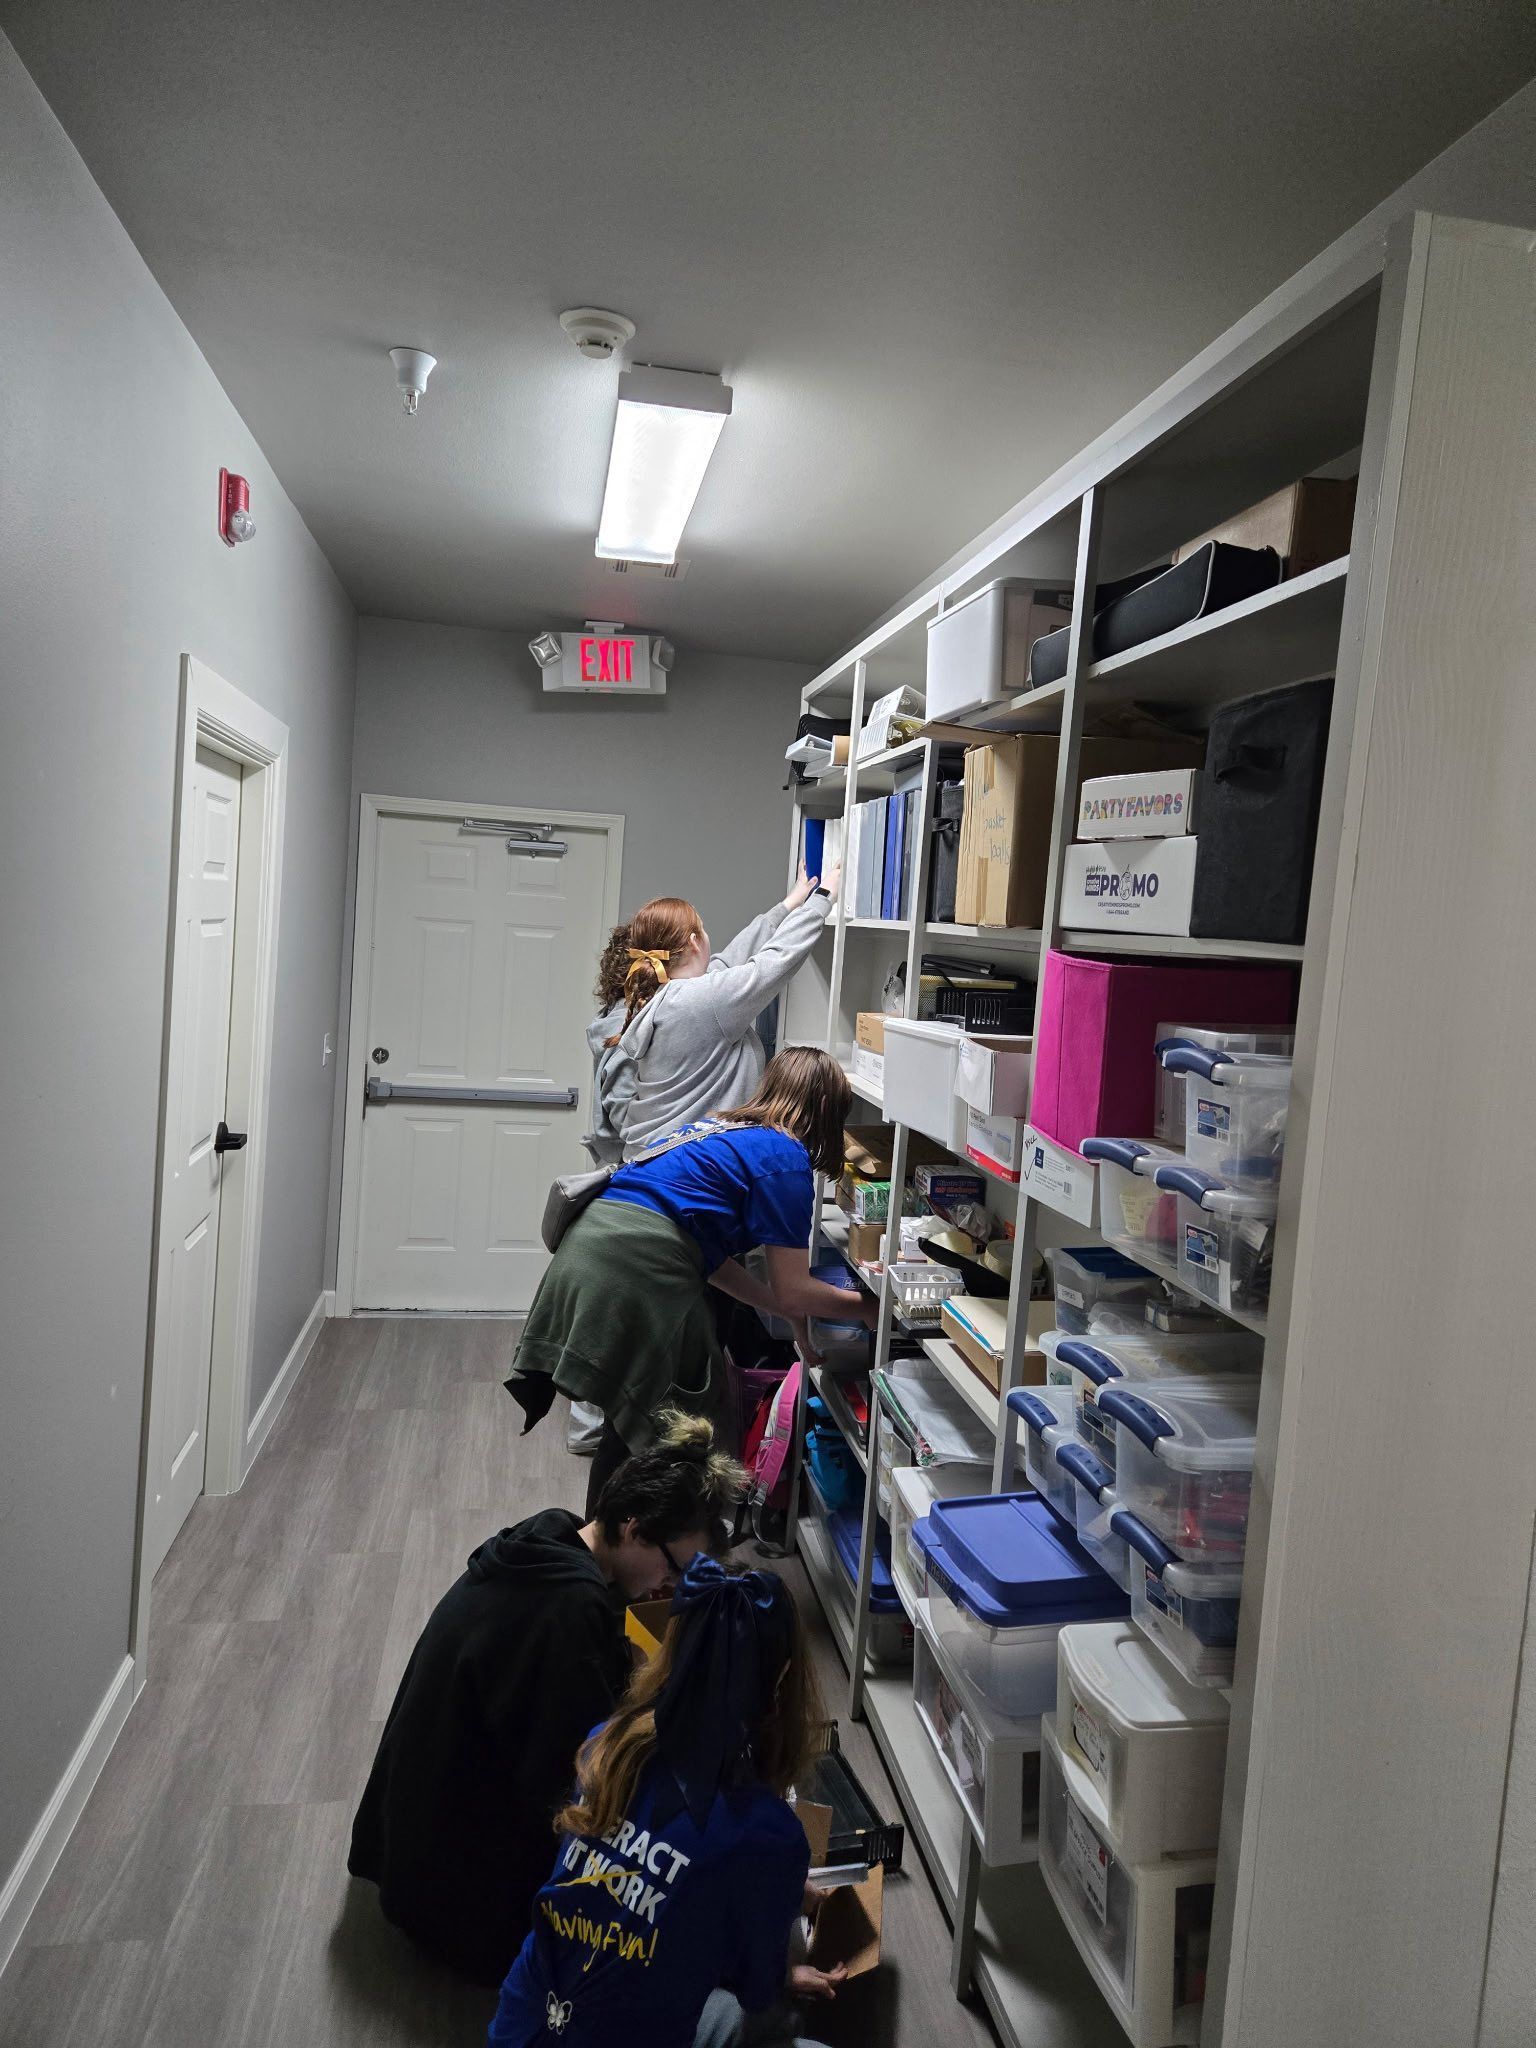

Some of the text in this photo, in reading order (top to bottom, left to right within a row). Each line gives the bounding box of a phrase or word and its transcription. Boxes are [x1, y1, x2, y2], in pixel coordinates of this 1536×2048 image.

[580, 638, 634, 682] EXIT
[598, 1818, 690, 1884] RACT
[582, 1849, 667, 1924] WORK
[541, 1901, 658, 1972] Having Fun!
